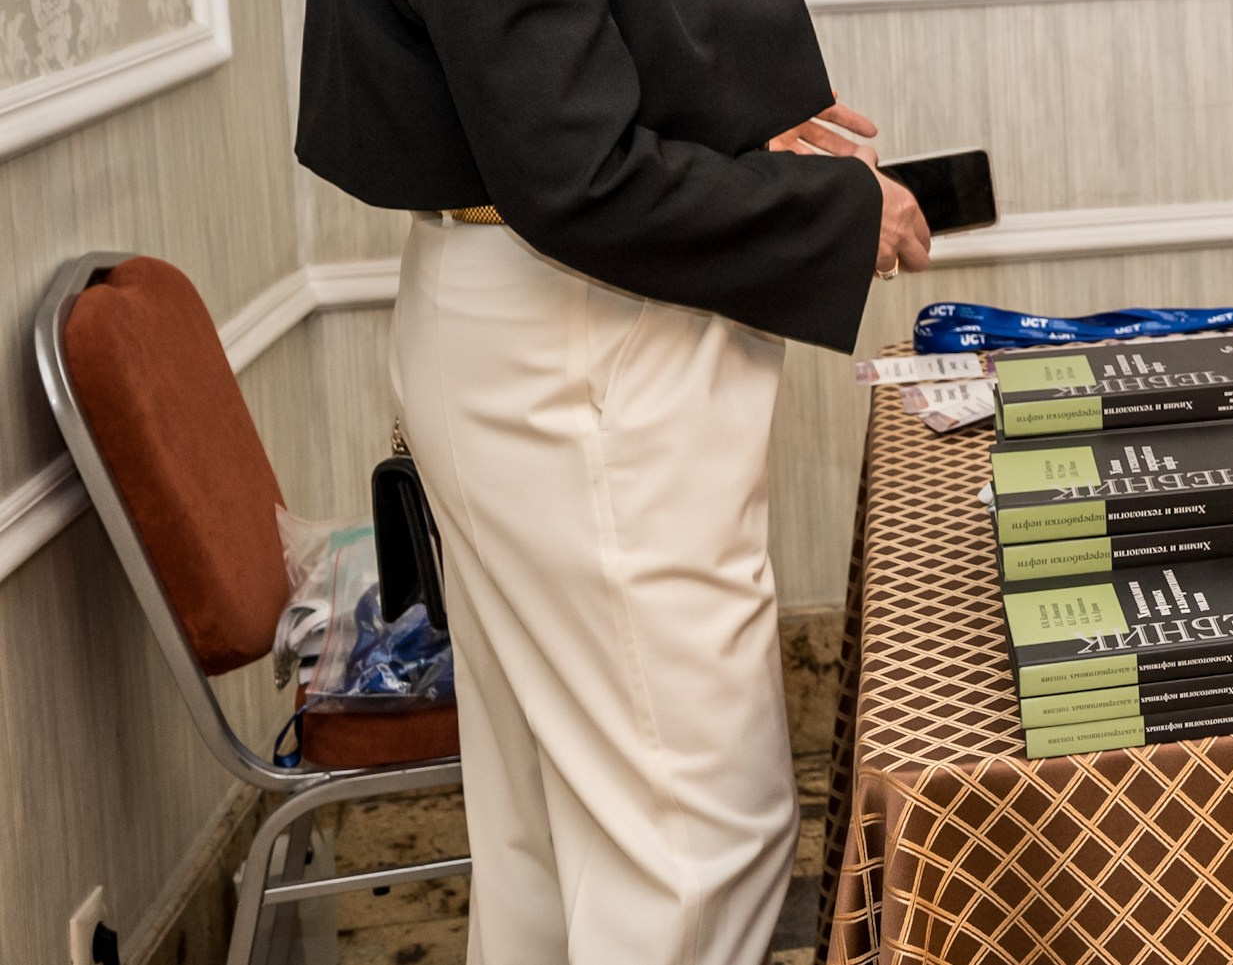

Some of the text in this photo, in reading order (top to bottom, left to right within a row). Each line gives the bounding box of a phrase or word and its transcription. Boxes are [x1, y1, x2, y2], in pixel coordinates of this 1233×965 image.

[1020, 317, 1048, 328] UCT
[960, 334, 986, 346] UCT
[1104, 404, 1153, 415] технология
[1163, 401, 1193, 411] Химия
[1016, 412, 1044, 423] нефти
[1046, 408, 1101, 420] переработки
[1108, 508, 1163, 520] технология
[1173, 504, 1206, 515] Химия
[1012, 518, 1042, 530] нефти
[1045, 513, 1105, 526] переработки
[1114, 546, 1168, 558] технология
[1179, 541, 1211, 552] Химия
[1017, 556, 1047, 568] нефти
[1050, 551, 1110, 564] переработки
[1139, 661, 1176, 672] нефтяных
[1178, 654, 1233, 667] Химмотология
[1041, 675, 1067, 683] топлив
[1140, 693, 1178, 705] нефтяных
[1042, 707, 1070, 715] топлив
[1146, 722, 1182, 734] нефтяных
[1048, 736, 1075, 745] топлив
